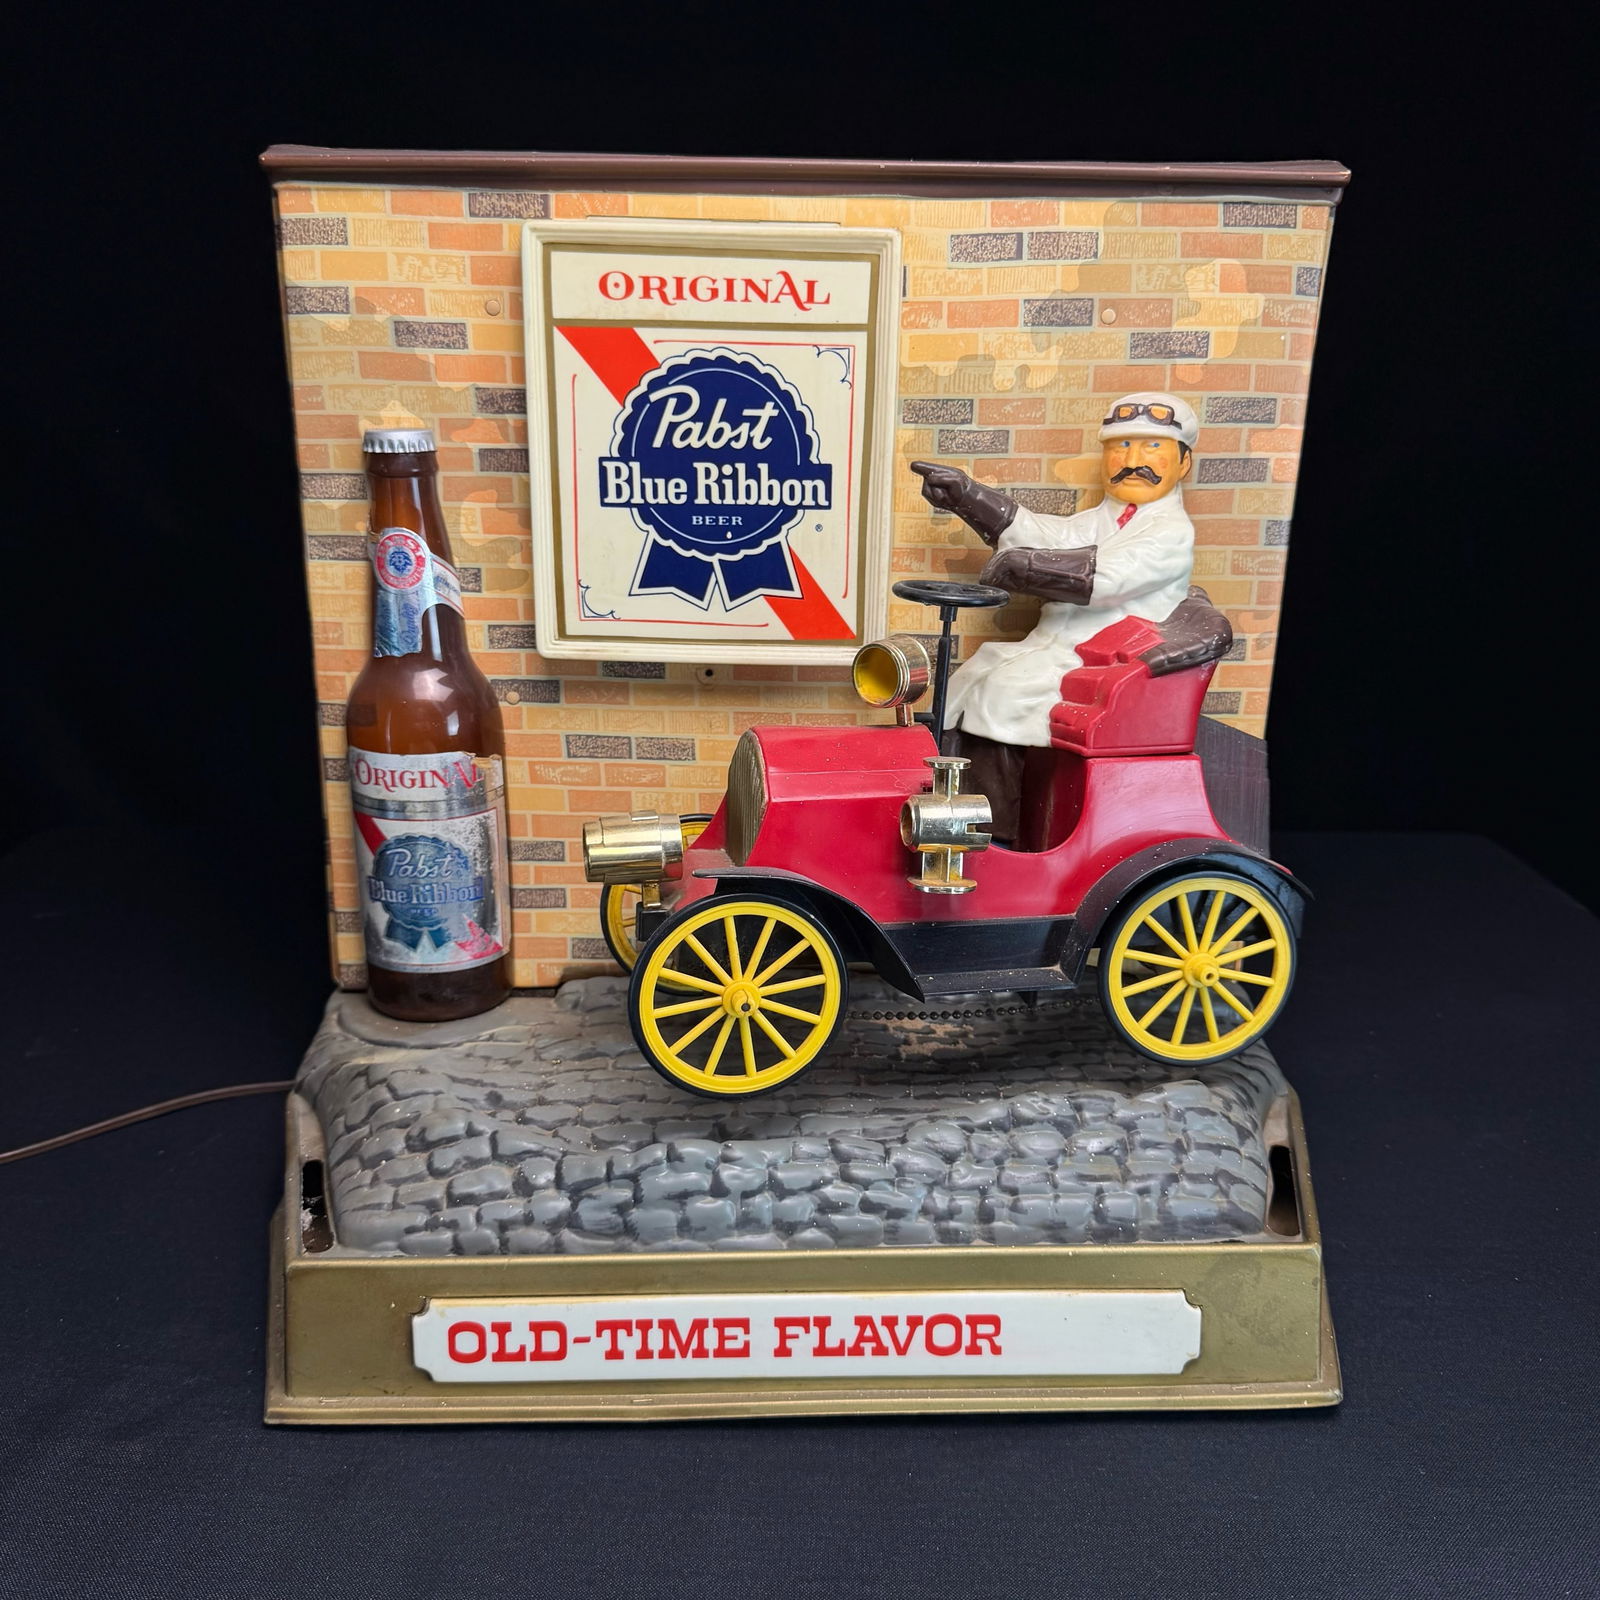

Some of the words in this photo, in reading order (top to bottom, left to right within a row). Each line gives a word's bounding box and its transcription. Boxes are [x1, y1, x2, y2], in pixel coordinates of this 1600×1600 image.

[598, 270, 831, 312] ORIGINAL
[648, 384, 779, 451] Pabst
[602, 460, 688, 505] Blue
[692, 462, 830, 507] Ribbon
[692, 515, 743, 527] BEER
[386, 848, 454, 878] Pabst
[370, 878, 408, 903] Blue
[409, 883, 482, 904] Ribbon
[447, 1317, 751, 1364] OLD-TIME
[773, 1313, 1003, 1358] FLAVOR
